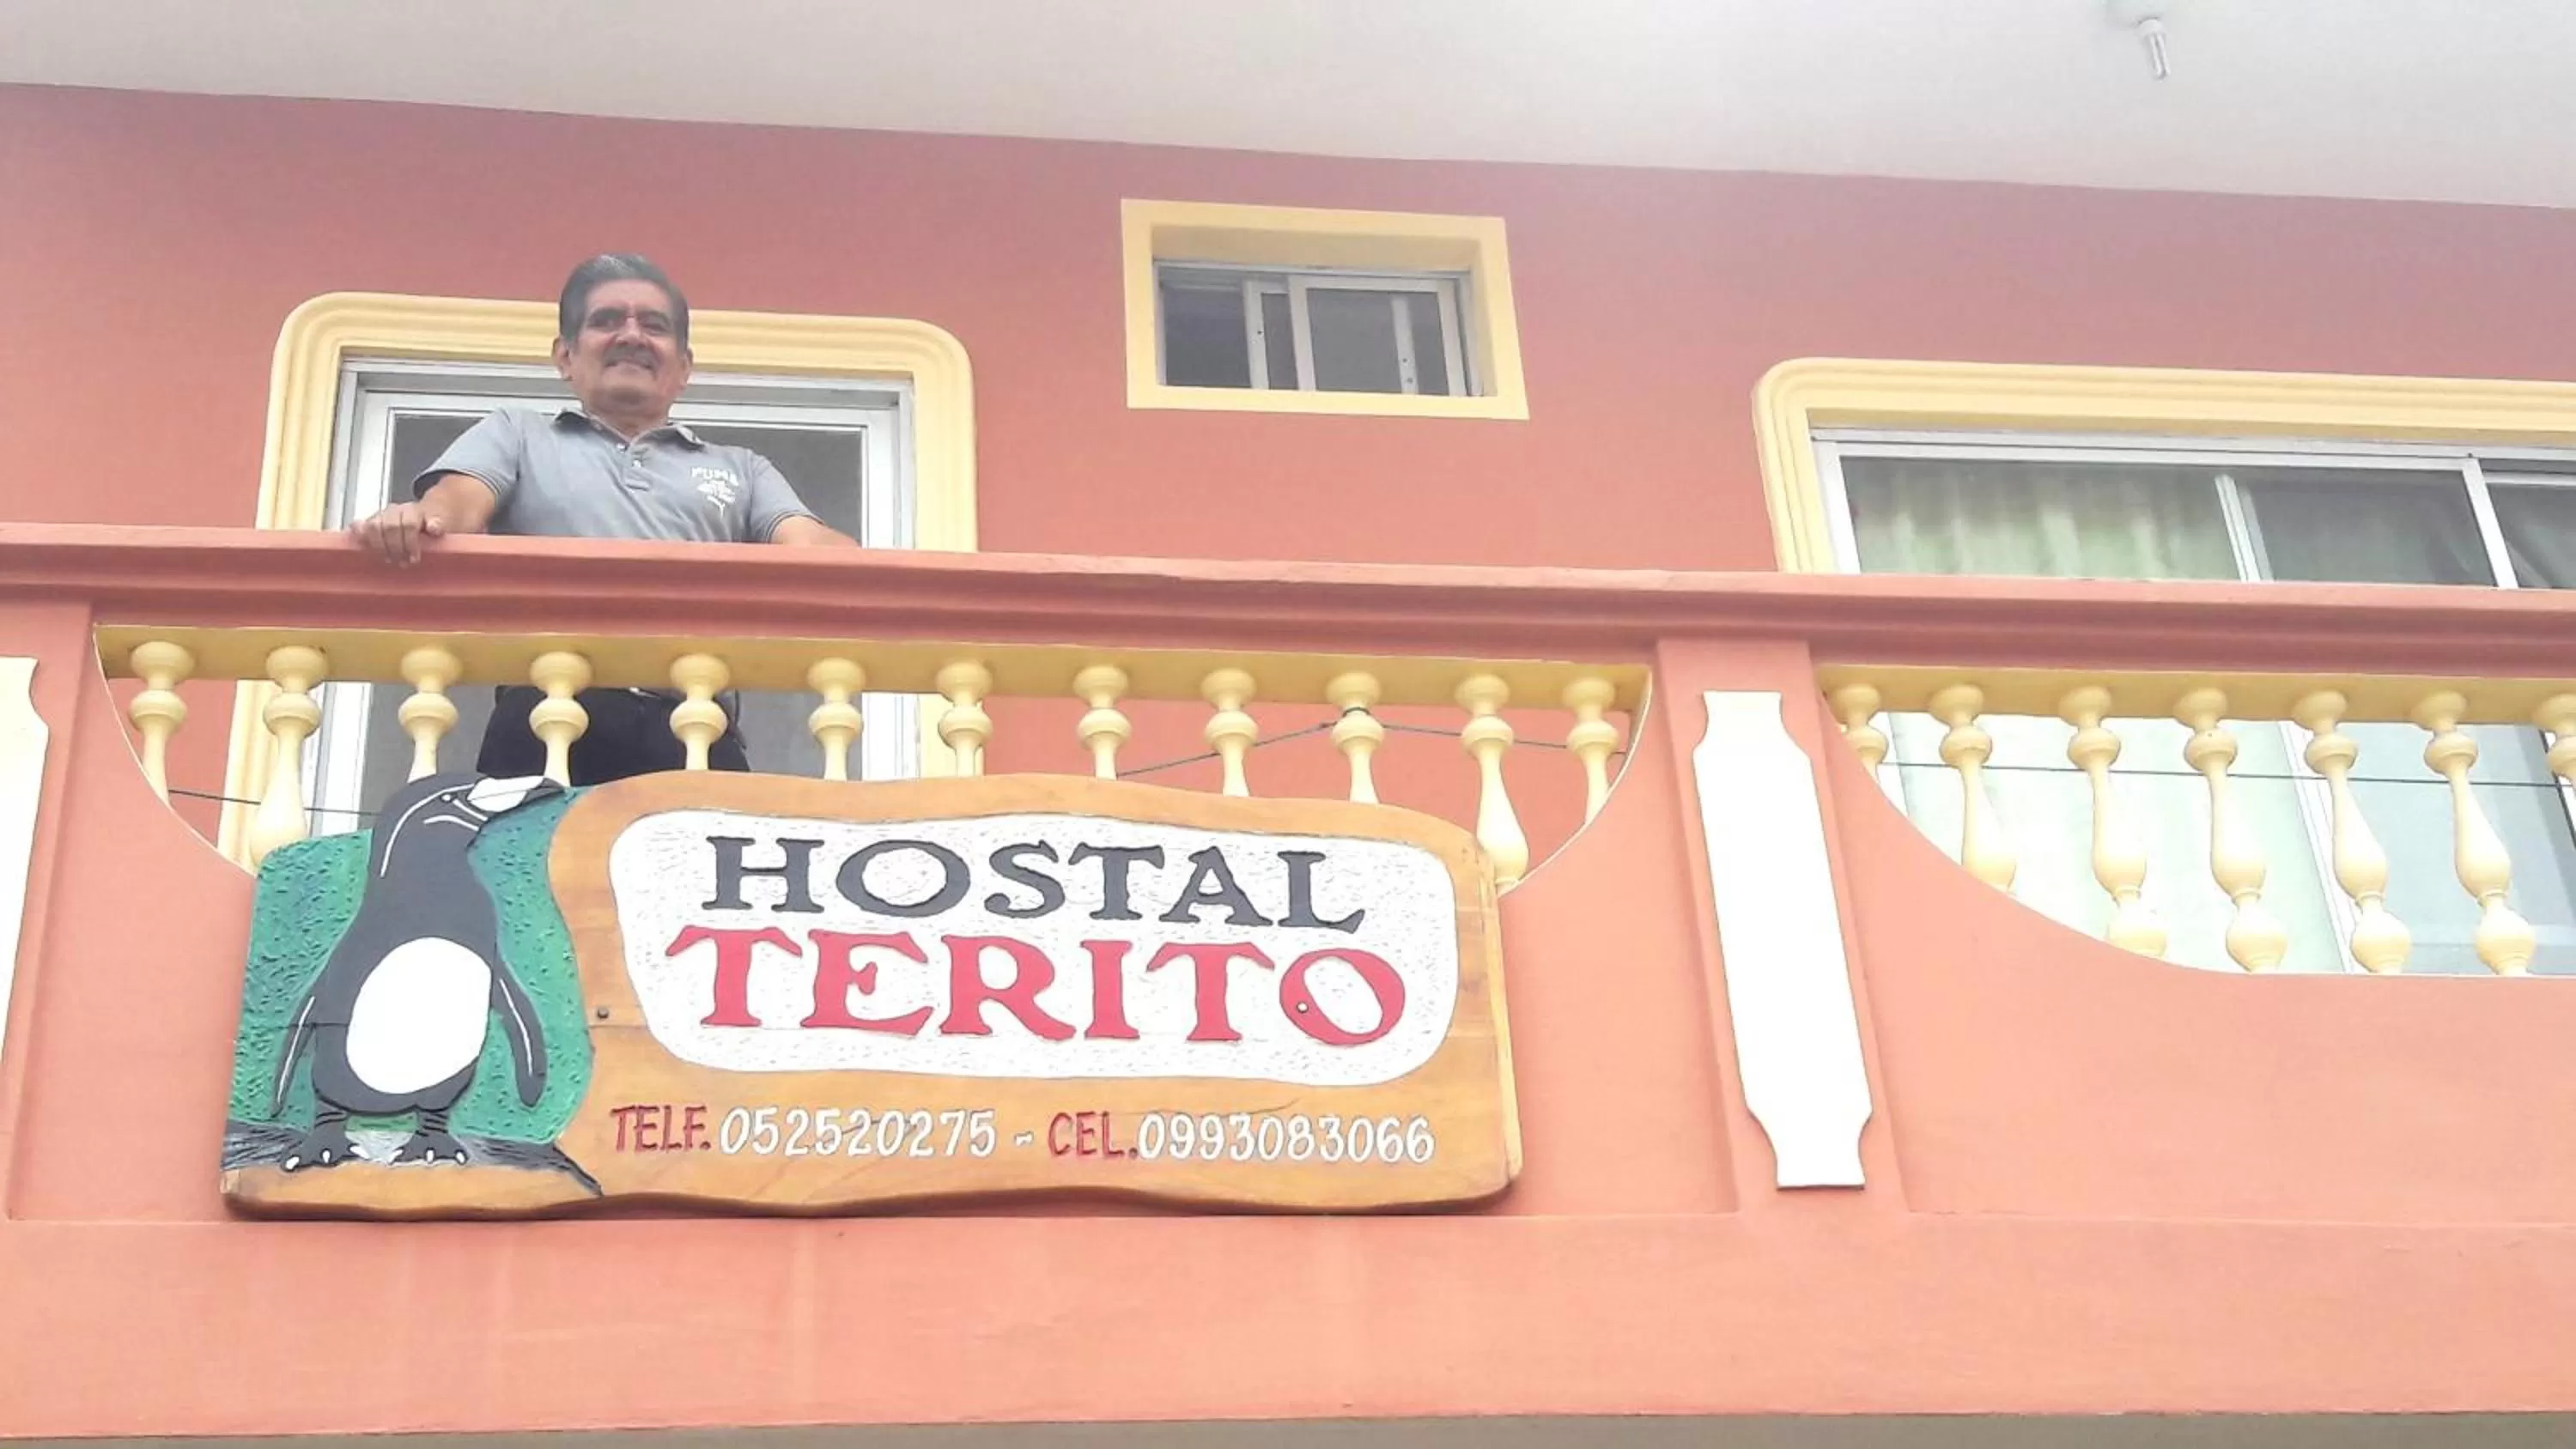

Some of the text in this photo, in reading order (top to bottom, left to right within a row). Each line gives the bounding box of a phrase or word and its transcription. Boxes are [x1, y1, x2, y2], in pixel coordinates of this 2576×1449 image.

[702, 836, 1365, 933] HOSTAL
[665, 926, 1406, 1046] TERITO
[610, 1106, 711, 1153] TELF.
[720, 1108, 997, 1157] 052520275
